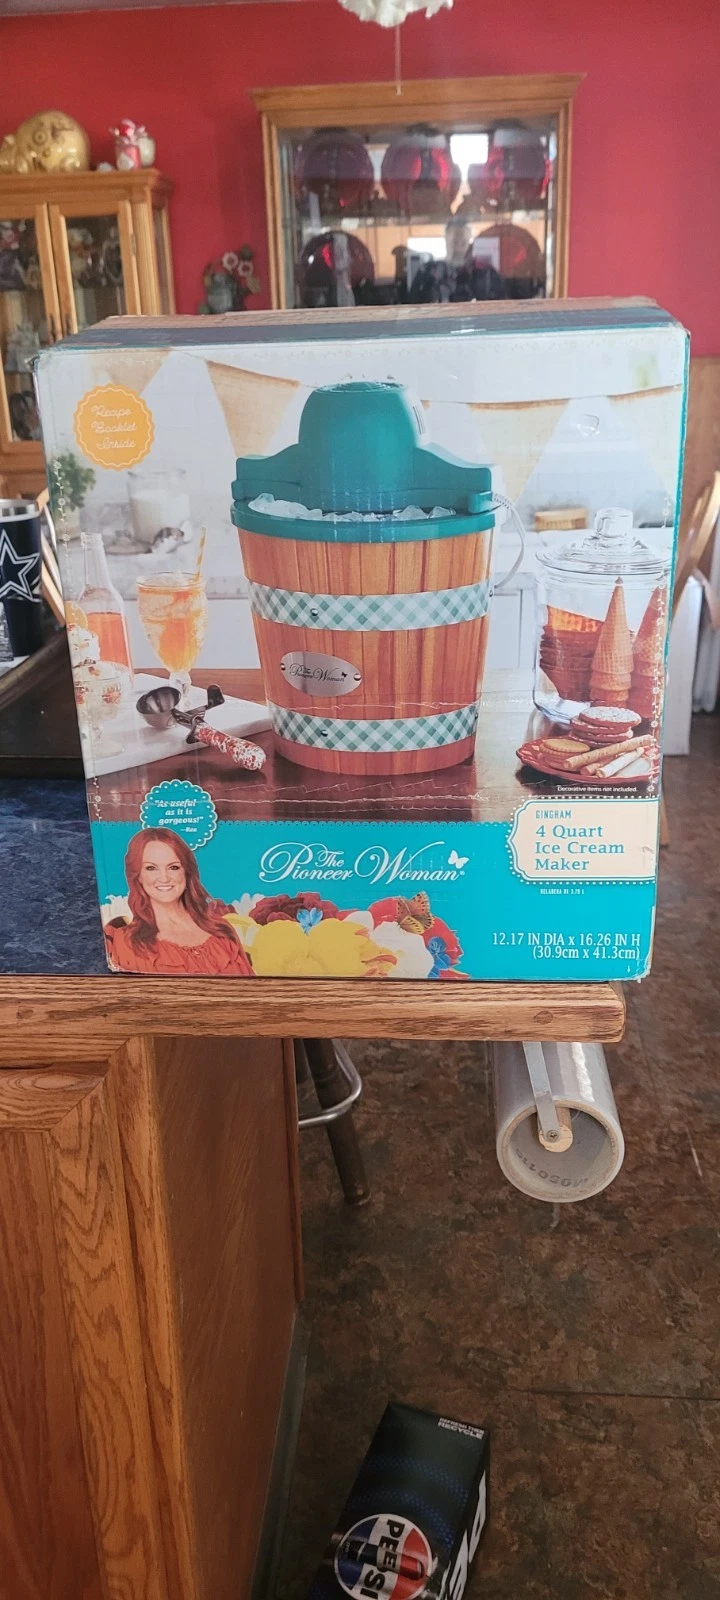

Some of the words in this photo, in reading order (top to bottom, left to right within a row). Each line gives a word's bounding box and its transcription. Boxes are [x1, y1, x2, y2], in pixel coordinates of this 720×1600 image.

[91, 405, 132, 420] Recipe
[91, 421, 137, 434] Booklet
[96, 437, 137, 449] Inside
[313, 667, 345, 682] Woman
[170, 799, 197, 808] useful
[535, 810, 572, 819] GINGHAM
[535, 825, 546, 838] 4
[552, 825, 604, 839] Quart
[535, 842, 561, 854] Ice
[567, 842, 625, 854] Cream
[259, 841, 353, 883] Pioneer
[315, 850, 345, 868] The
[534, 858, 590, 870] Maker
[492, 933, 524, 945] 12.17
[527, 933, 541, 945] IN
[544, 933, 565, 946] DIA
[569, 937, 576, 945] x
[579, 933, 611, 946] 16.26
[615, 934, 628, 946] IN
[632, 934, 641, 946] H
[533, 945, 579, 960] (30.9cm
[583, 950, 590, 959] x
[593, 946, 640, 961] 41.3cm)
[438, 1422, 483, 1440] RECYCLE
[468, 1425, 485, 1435] THEN
[360, 1519, 405, 1599] PESI
